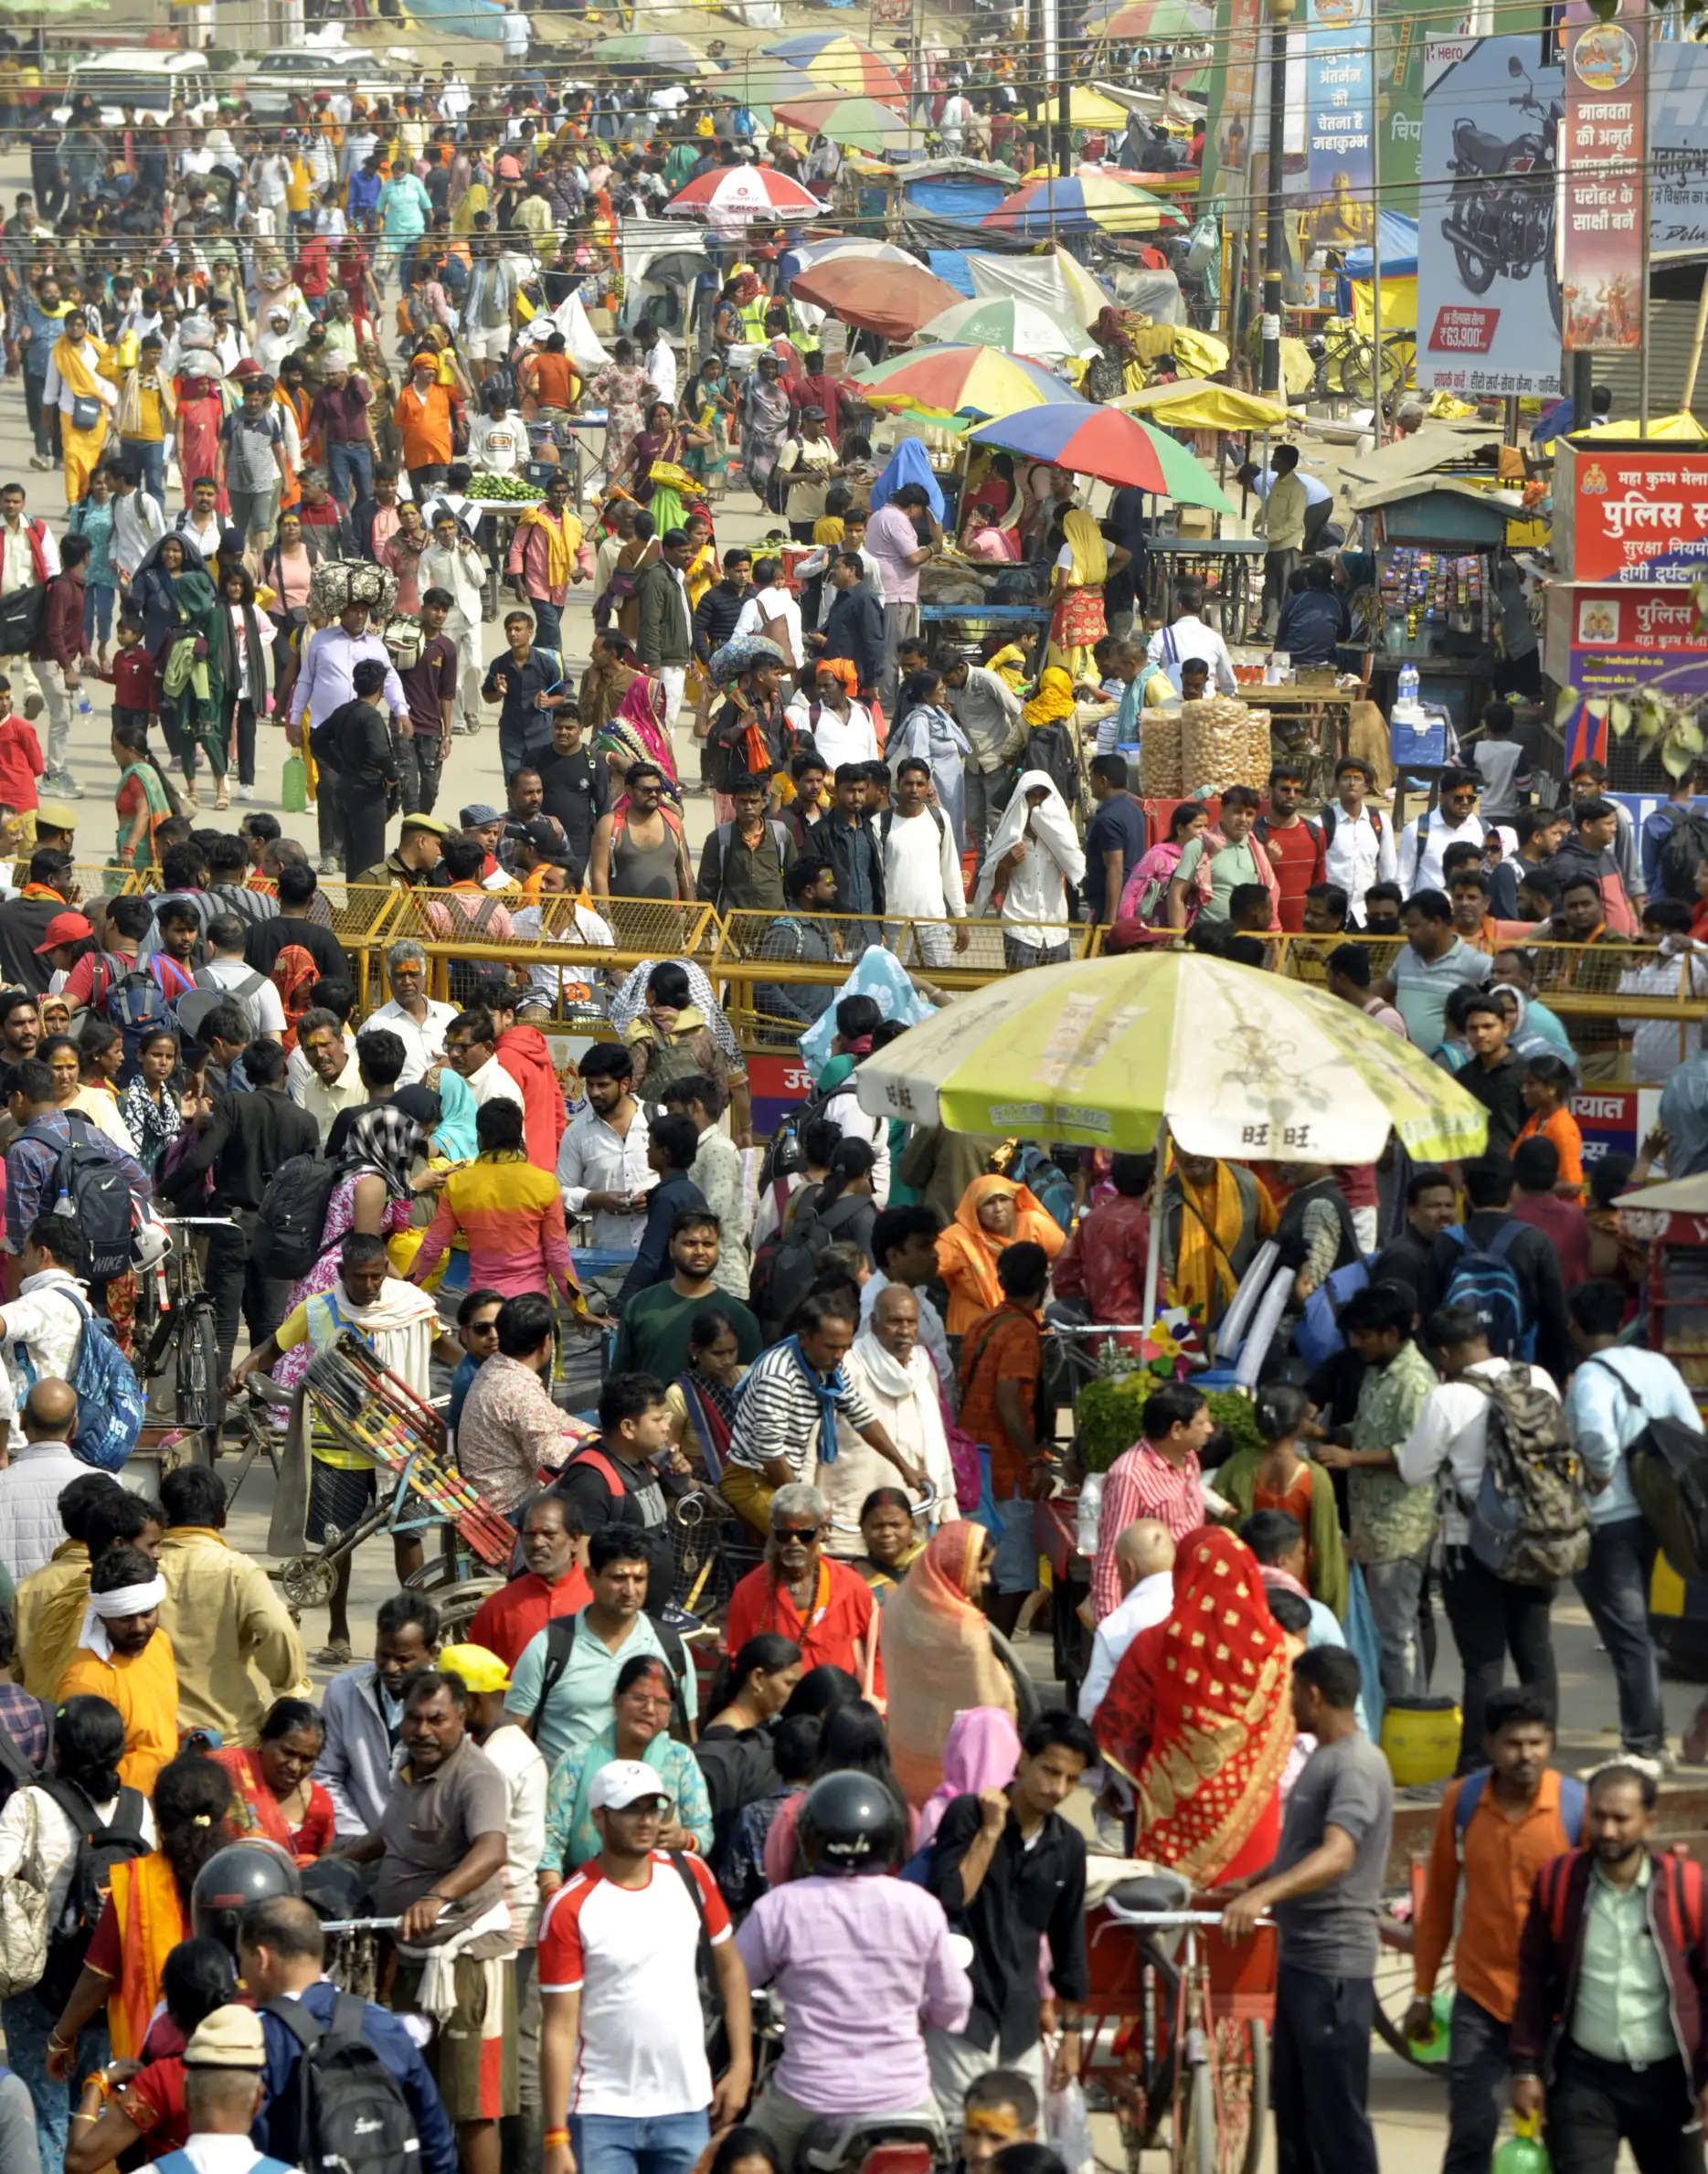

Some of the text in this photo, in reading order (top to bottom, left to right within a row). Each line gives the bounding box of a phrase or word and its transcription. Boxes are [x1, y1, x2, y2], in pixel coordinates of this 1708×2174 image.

[1331, 89, 1349, 107] की
[1577, 103, 1632, 121] मानवता
[1318, 114, 1351, 131] चेतना
[1312, 135, 1369, 154] महाकुम्भ
[1575, 125, 1595, 146] की
[1574, 183, 1634, 205] धरोहर के
[1573, 209, 1637, 231] साक्षी बनें
[1618, 467, 1708, 491] महा कुम्भ मेला
[1602, 491, 1682, 538] पुलिस
[1623, 540, 1662, 560] सुरक्षा
[1619, 561, 1650, 583] होगी
[1636, 598, 1692, 632] पुलिस
[1635, 634, 1654, 647] महा
[93, 1255, 124, 1273] NIKE
